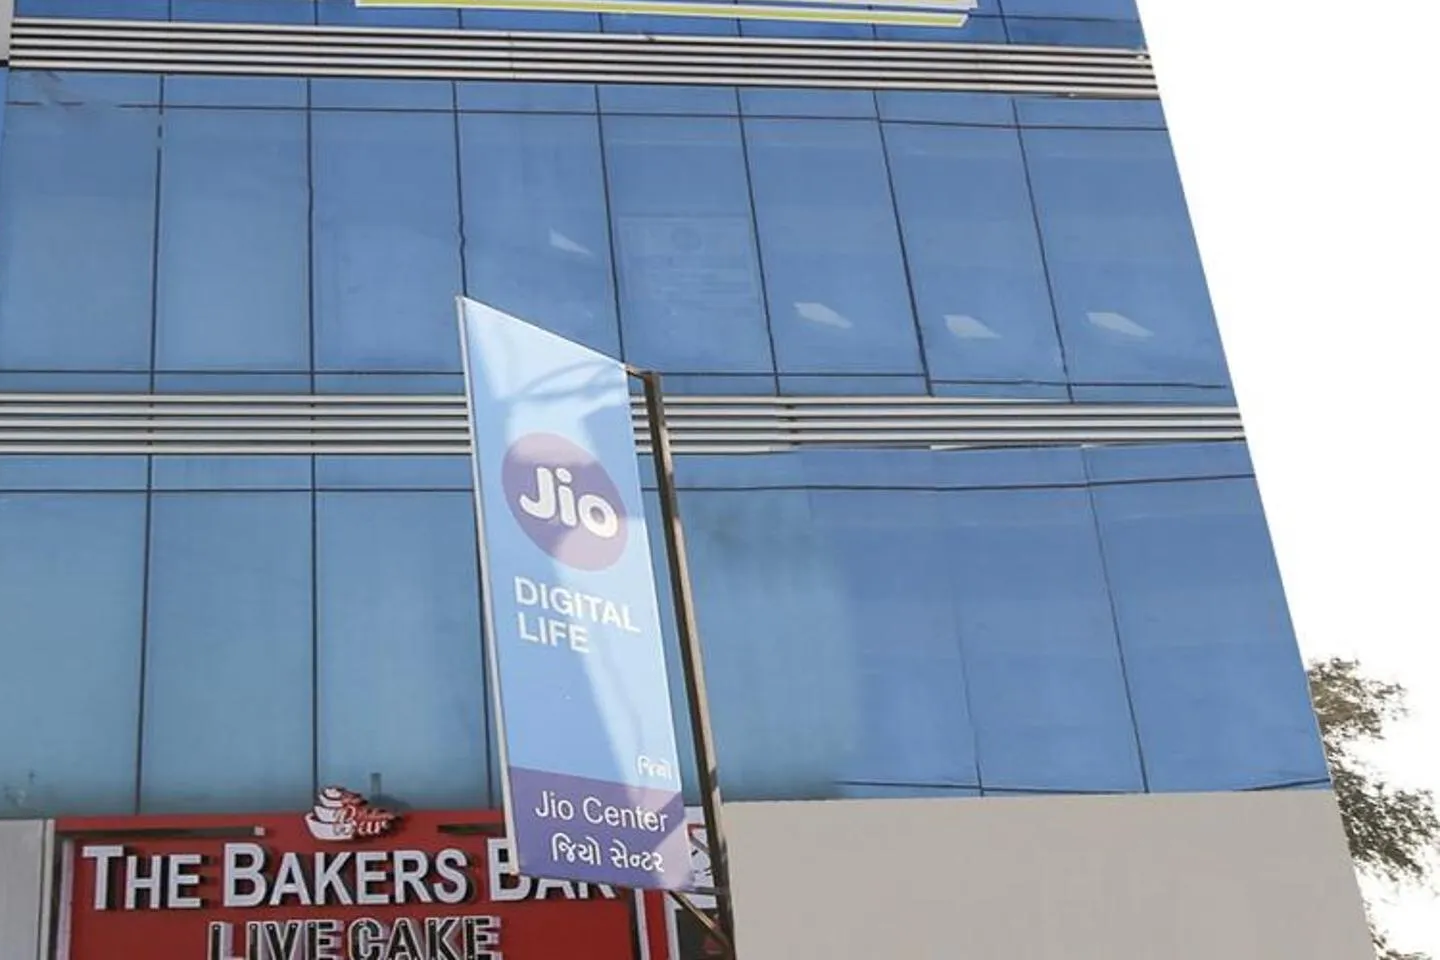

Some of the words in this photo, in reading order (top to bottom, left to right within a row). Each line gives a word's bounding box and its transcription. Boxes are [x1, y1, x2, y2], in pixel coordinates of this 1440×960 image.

[519, 467, 618, 539] Jio
[514, 576, 641, 633] DIGITAL
[517, 612, 590, 654] LIFE
[535, 791, 575, 820] Jio
[583, 797, 669, 832] Center
[82, 845, 202, 910] THE
[223, 842, 468, 907] BAKERS
[208, 918, 342, 960] LIVE
[347, 916, 501, 960] CAKE
